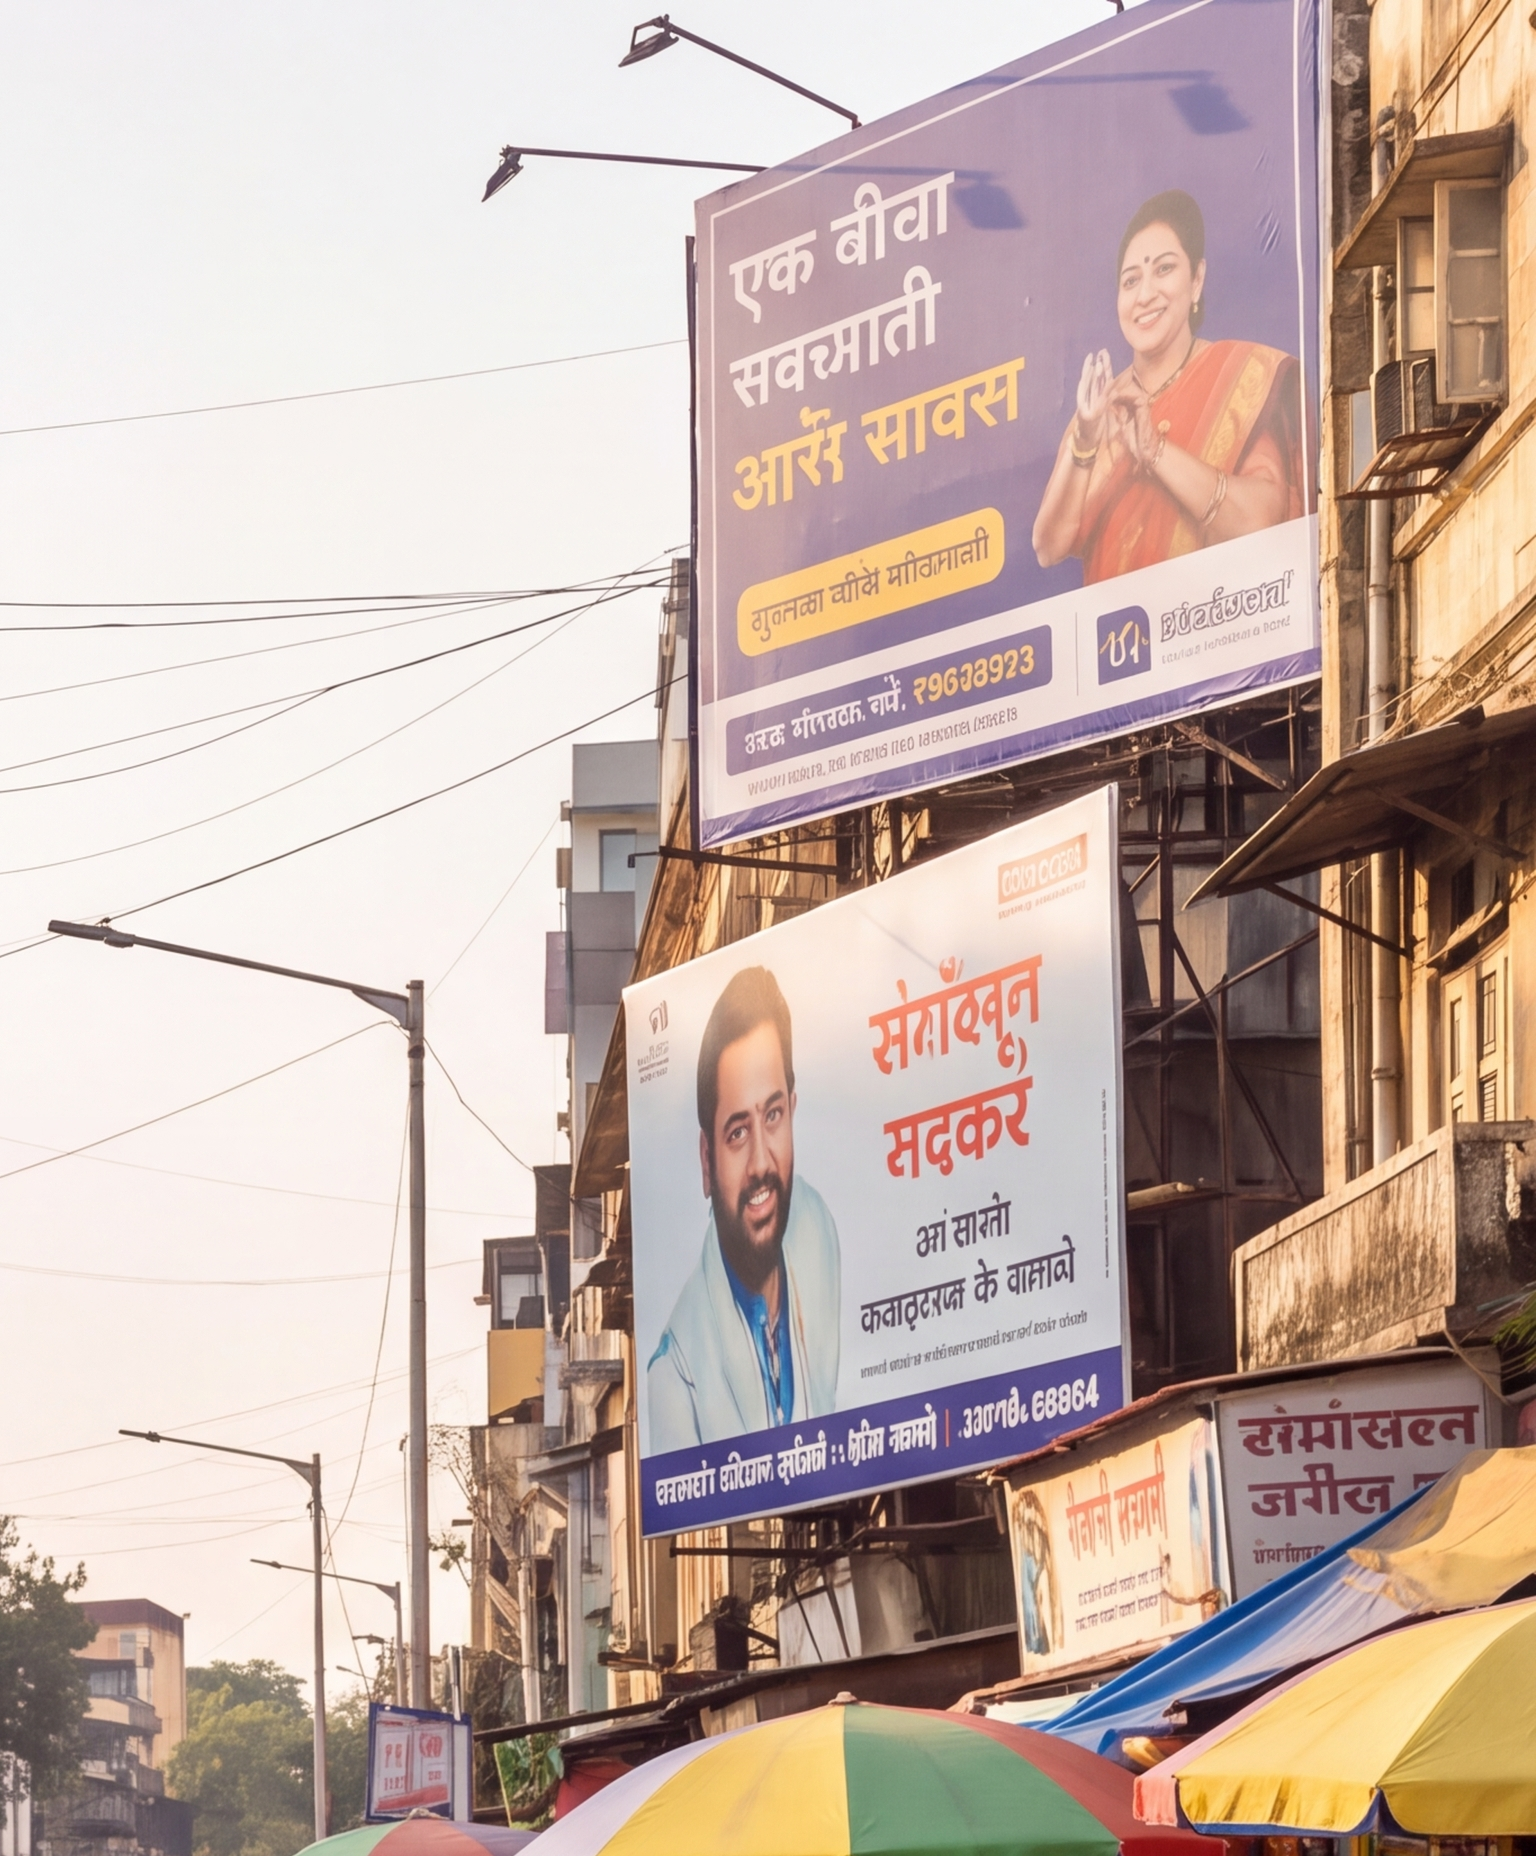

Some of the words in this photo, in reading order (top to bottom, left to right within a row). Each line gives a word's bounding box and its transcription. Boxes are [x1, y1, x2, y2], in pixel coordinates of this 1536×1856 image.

[729, 229, 817, 323] एक
[830, 171, 955, 266] बीवा
[861, 356, 1026, 465] सावस
[974, 1258, 999, 1303] के
